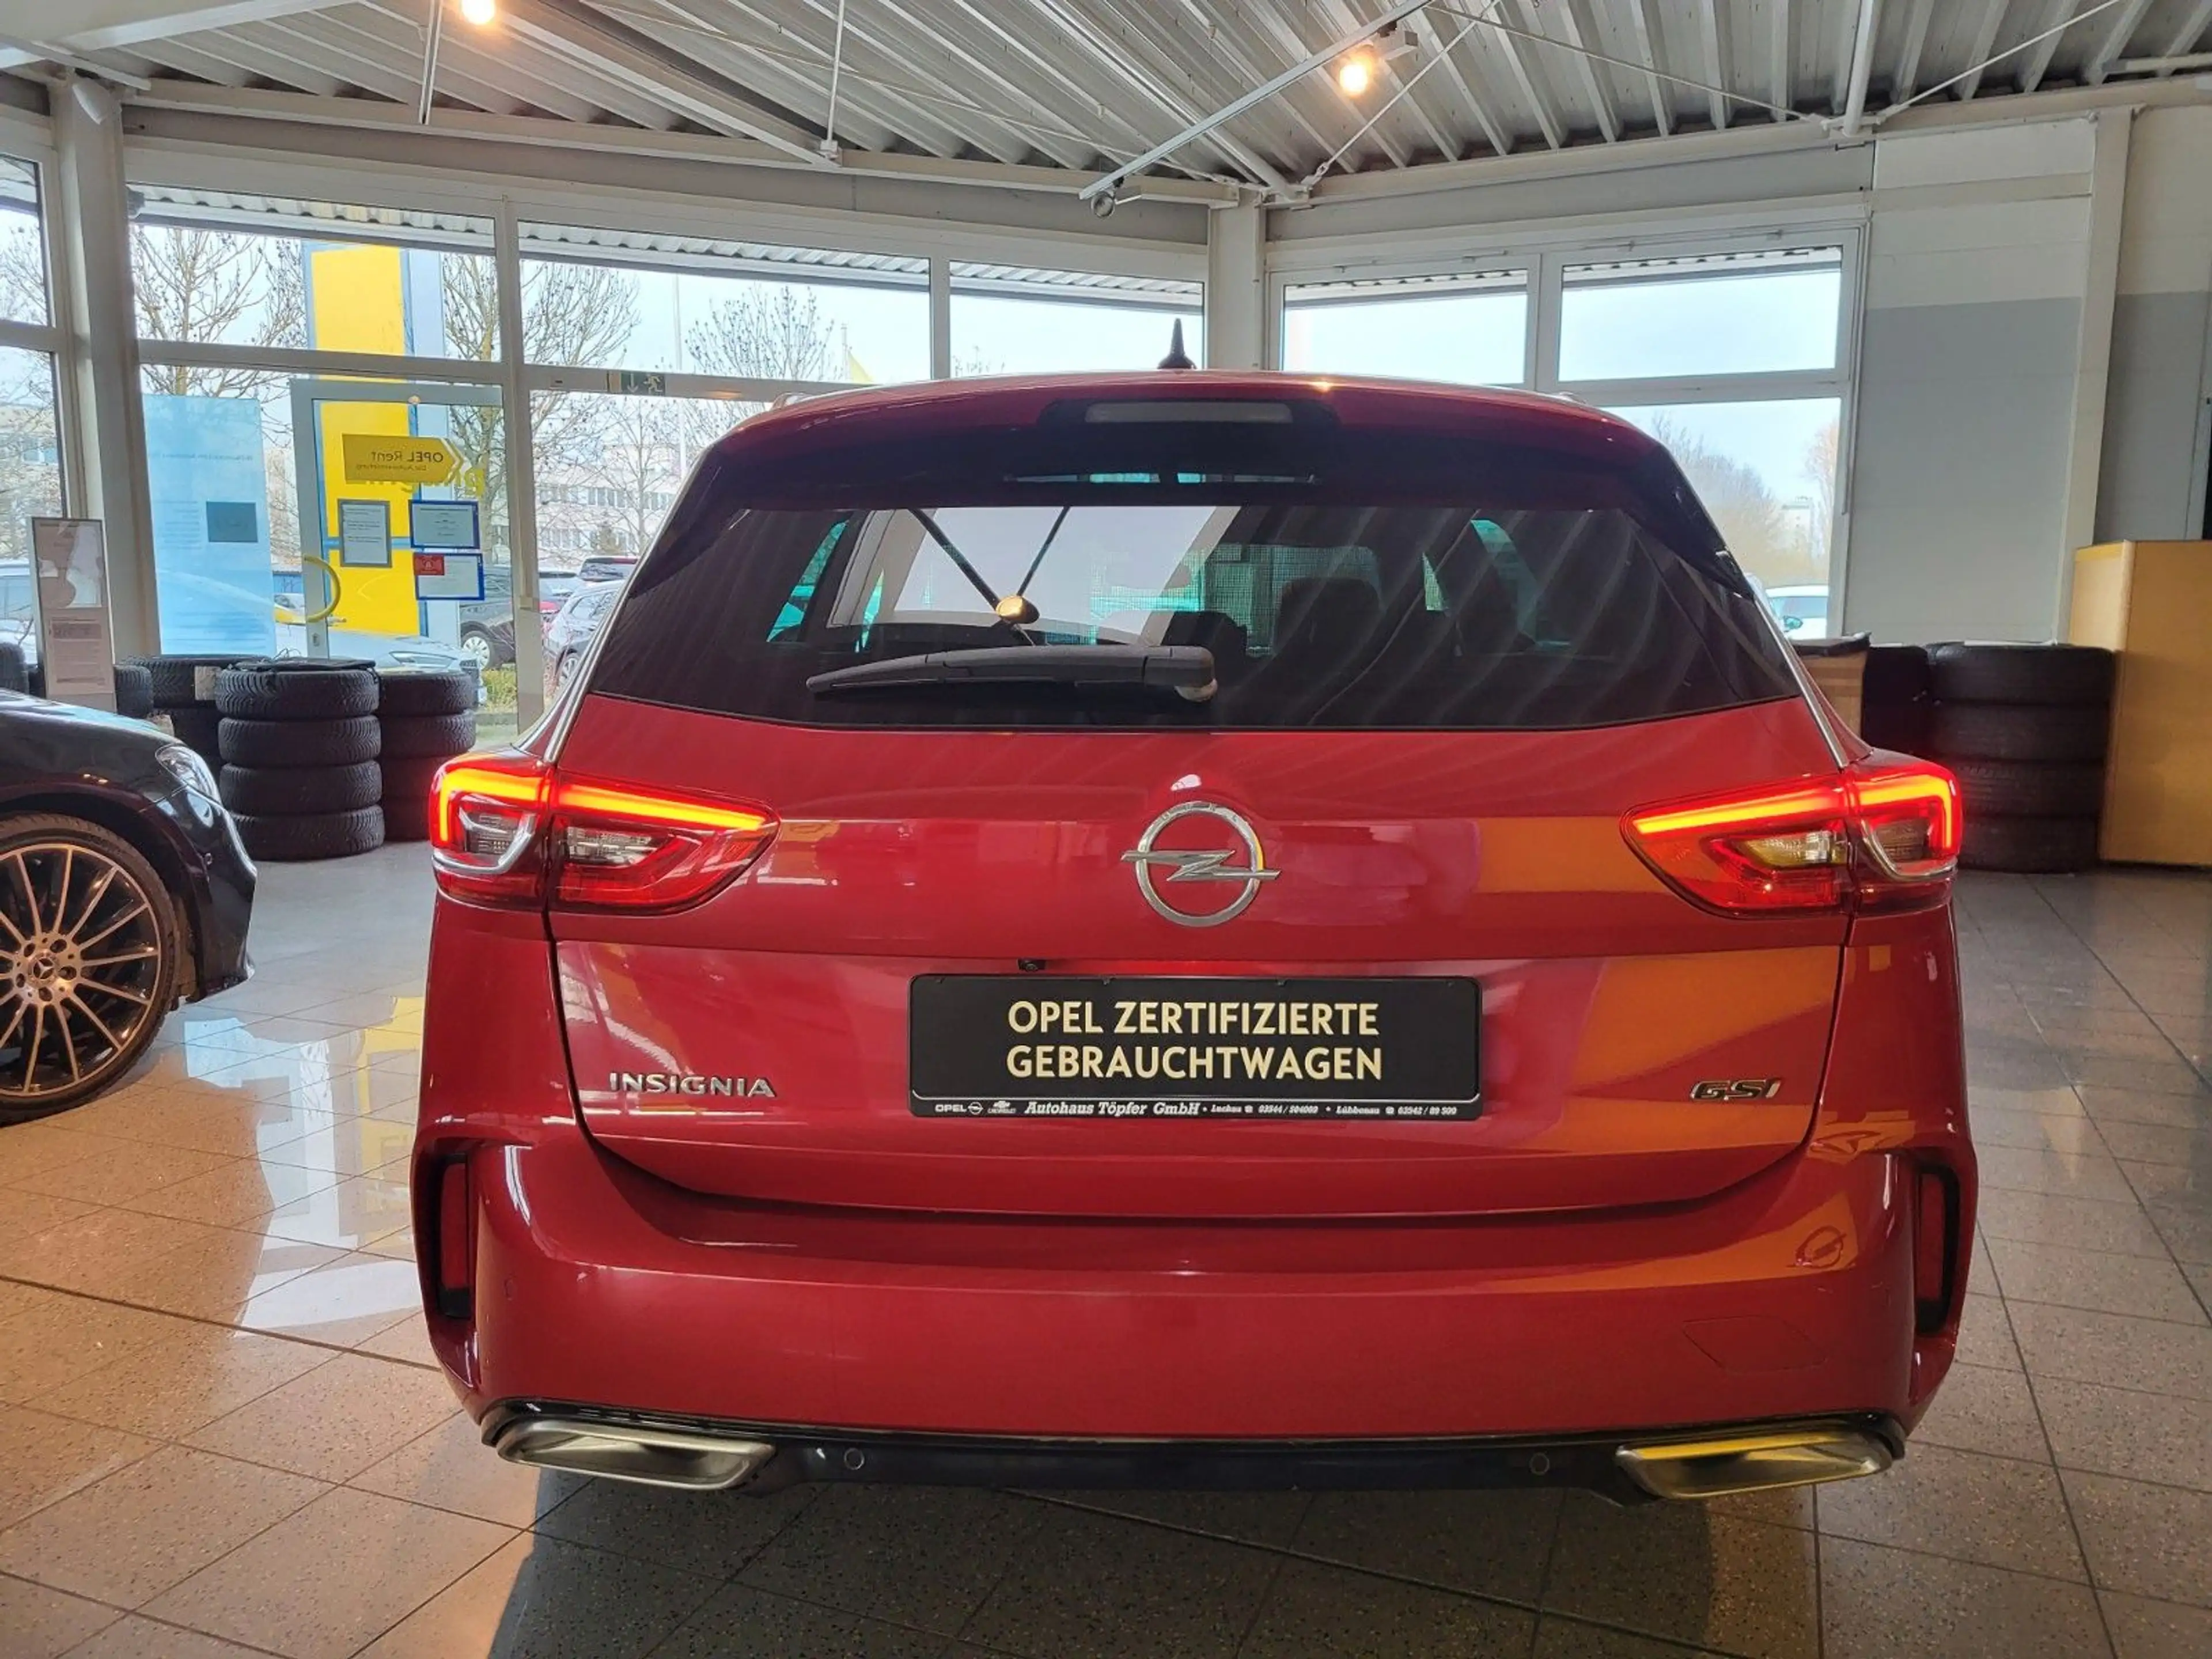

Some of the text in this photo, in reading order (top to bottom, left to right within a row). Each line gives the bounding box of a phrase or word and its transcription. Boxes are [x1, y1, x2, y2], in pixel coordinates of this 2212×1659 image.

[1008, 1001, 1380, 1035] OPEL ZERTIFIZIERTE
[1006, 1044, 1382, 1081] GEBRAUCHTWAGEN
[609, 1072, 777, 1097] INSIGNIA
[934, 1104, 967, 1113] OPEL
[1024, 1101, 1094, 1114] Autohaus
[1097, 1101, 1147, 1117] Töpfer
[1153, 1101, 1200, 1115] GmbH
